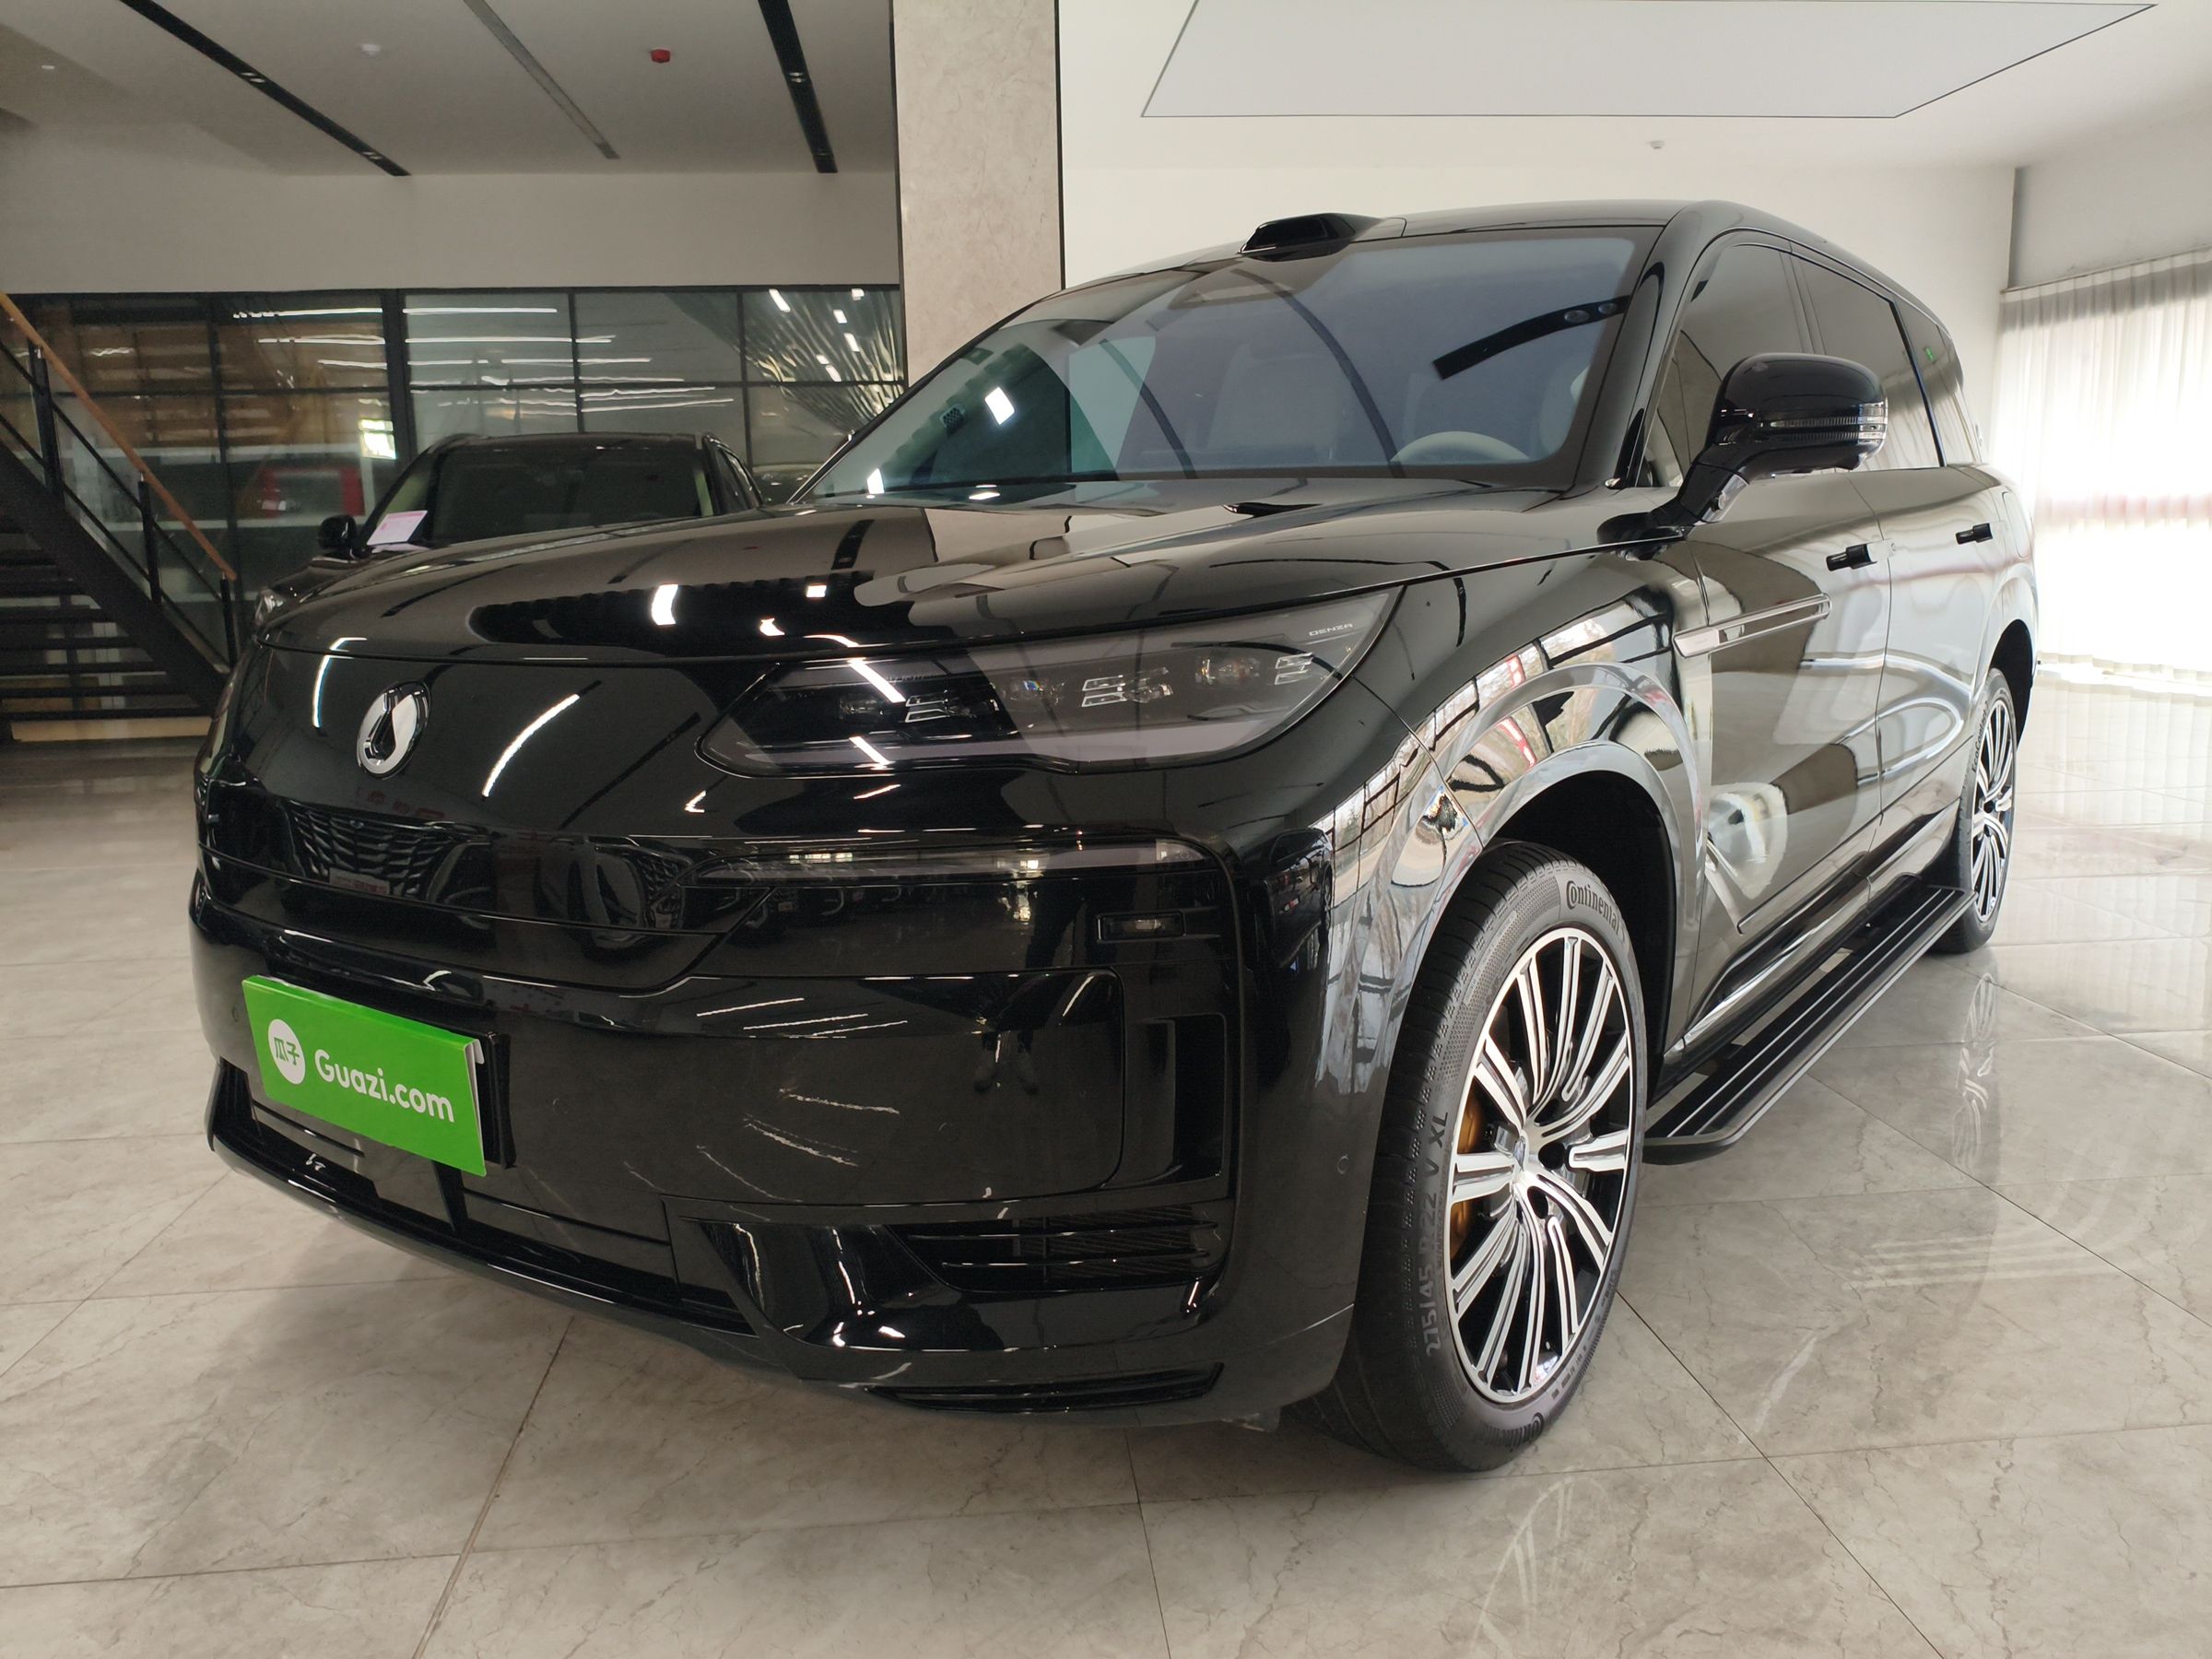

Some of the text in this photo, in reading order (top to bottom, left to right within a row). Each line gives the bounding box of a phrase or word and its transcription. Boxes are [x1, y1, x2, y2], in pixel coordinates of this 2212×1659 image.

[1308, 623, 1354, 637] DENZA
[1566, 879, 1620, 937] Continental
[274, 1036, 300, 1065] 瓜子
[313, 1048, 455, 1124] Guazi.com
[1428, 1112, 1448, 1148] XL
[1418, 1263, 1441, 1358] 275/45
